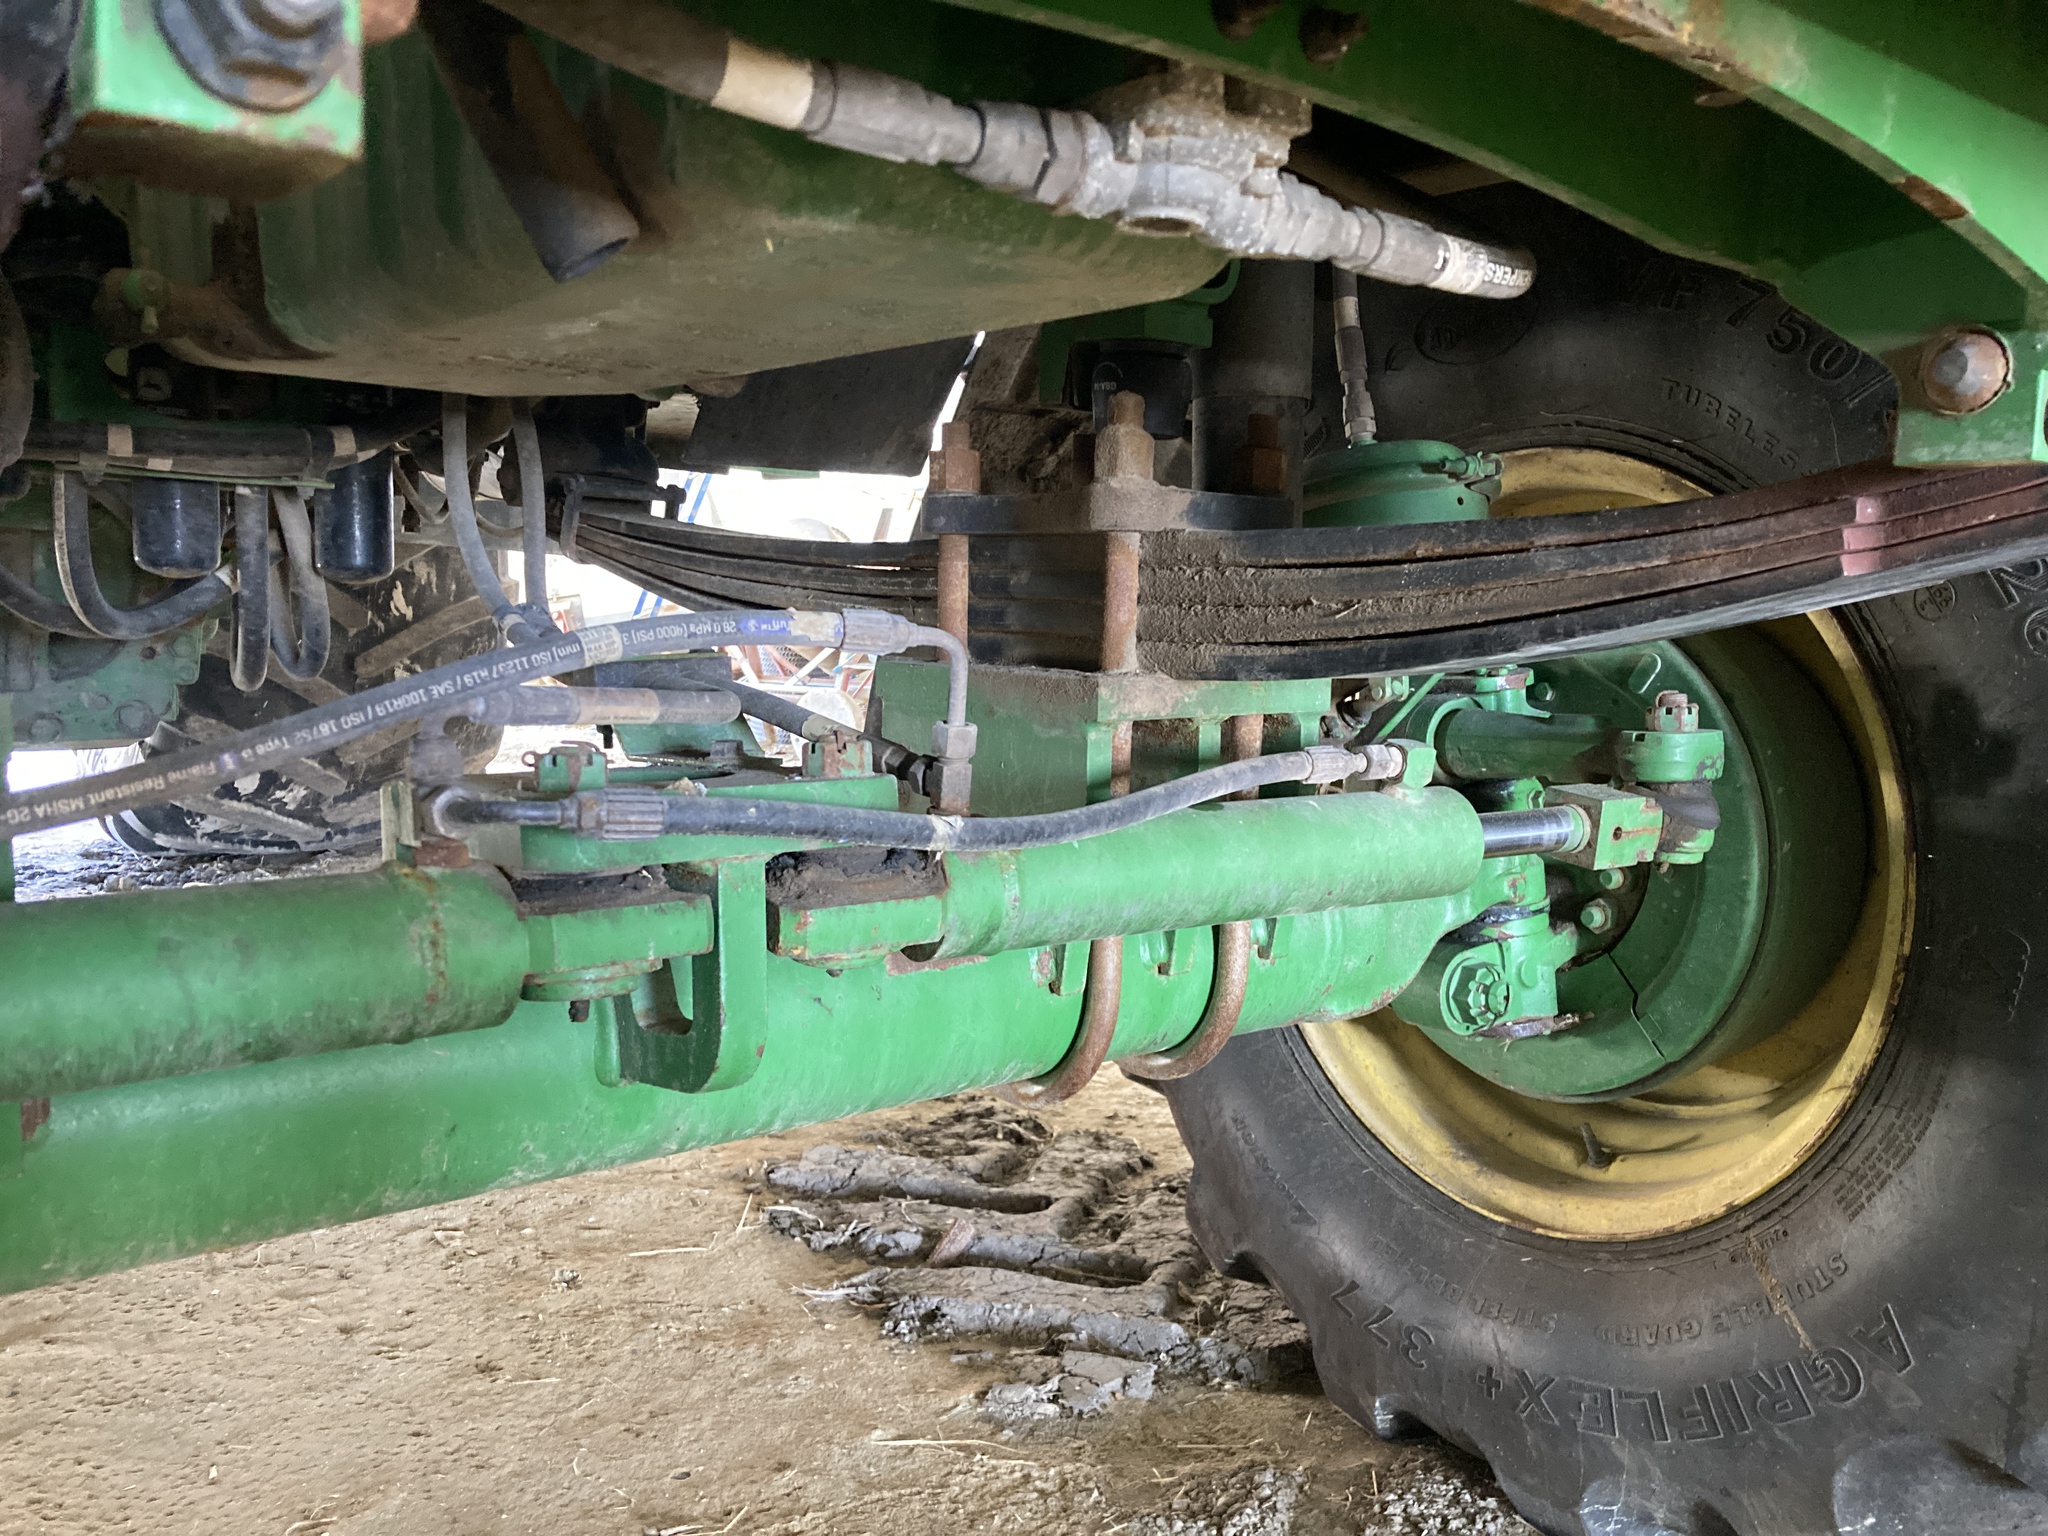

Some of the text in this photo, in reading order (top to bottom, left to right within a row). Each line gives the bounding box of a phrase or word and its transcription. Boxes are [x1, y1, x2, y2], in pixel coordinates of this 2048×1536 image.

[1661, 377, 1822, 477] TUBELES
[689, 621, 711, 636] MPa
[532, 651, 553, 666] ISO
[429, 681, 456, 699] SAE
[375, 688, 427, 716] 100R19
[340, 711, 366, 730] ISO
[255, 736, 291, 755] Type
[167, 760, 217, 783] Flame
[90, 774, 166, 805] Resistant
[34, 799, 86, 819] MSHA
[1367, 1235, 1558, 1334] STEEL BELTED
[1595, 1253, 1848, 1346] STUBLE GUARD
[1330, 1279, 1435, 1370] 377
